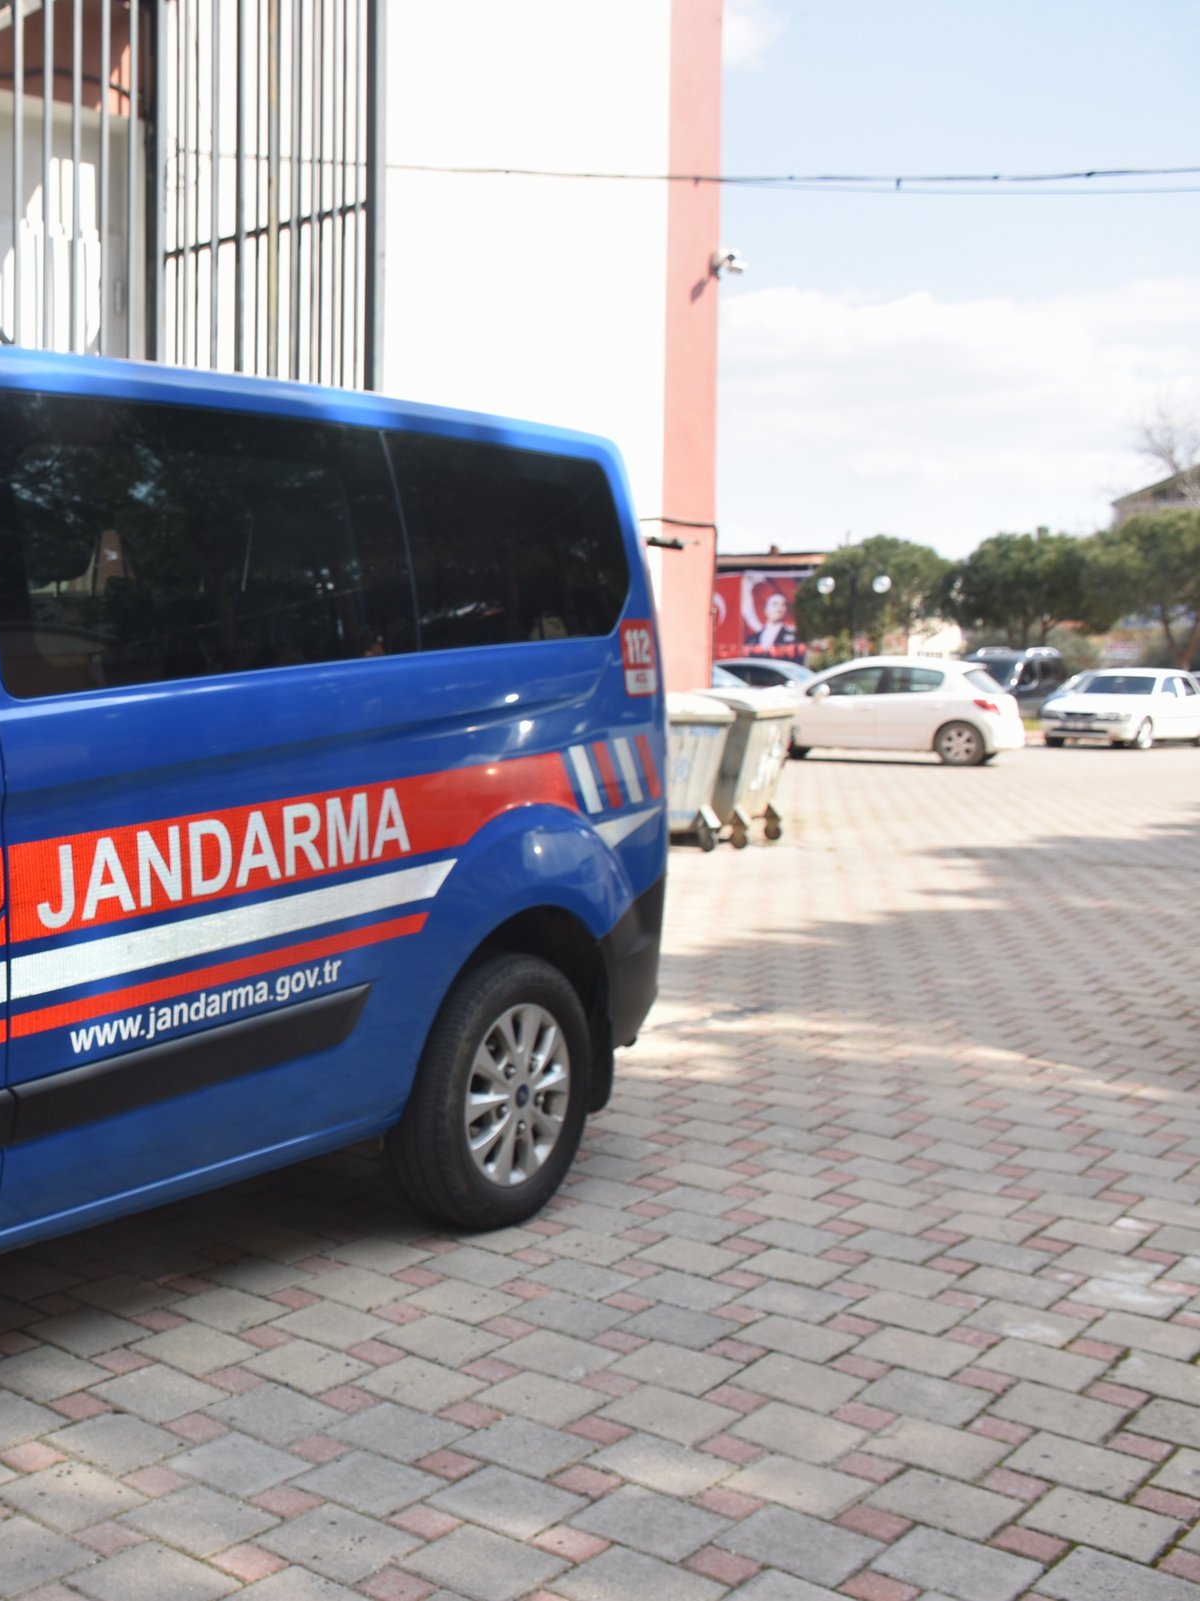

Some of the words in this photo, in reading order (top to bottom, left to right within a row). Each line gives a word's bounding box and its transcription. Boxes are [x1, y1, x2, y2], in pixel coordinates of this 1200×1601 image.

[625, 629, 652, 665] 112
[36, 787, 411, 929] JANDARMA
[69, 959, 342, 1054] www.jandarma.gov.tr
